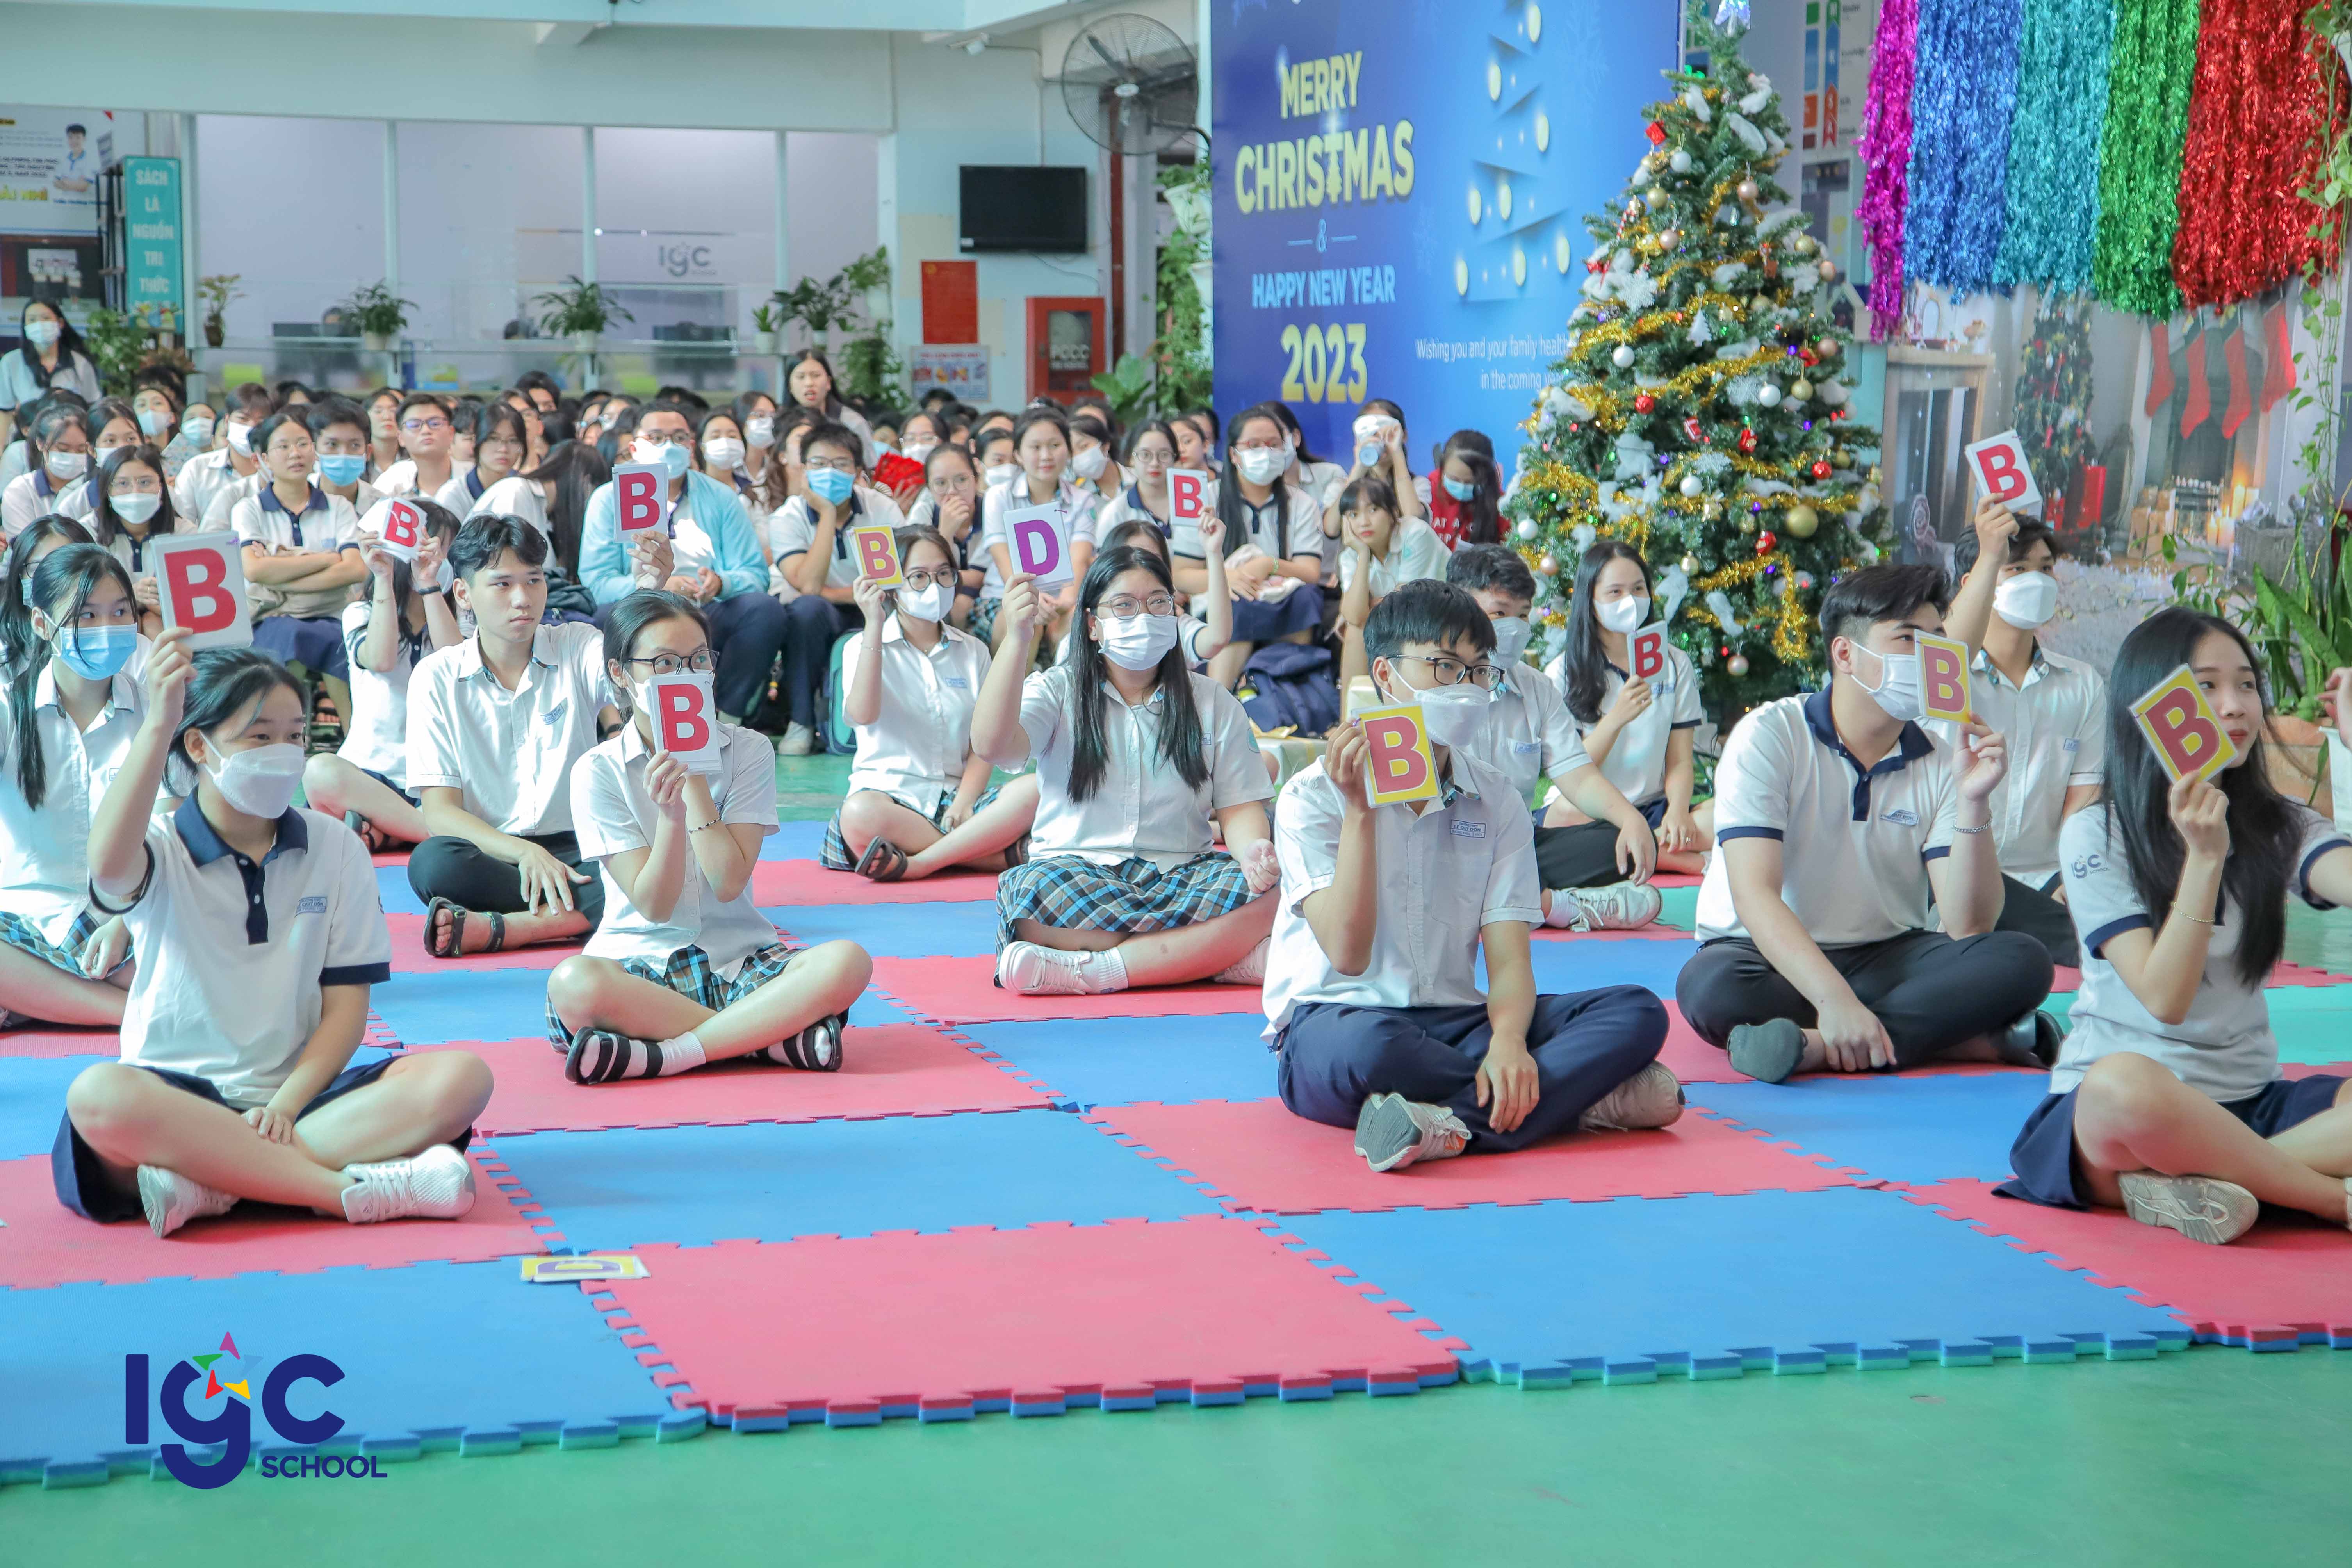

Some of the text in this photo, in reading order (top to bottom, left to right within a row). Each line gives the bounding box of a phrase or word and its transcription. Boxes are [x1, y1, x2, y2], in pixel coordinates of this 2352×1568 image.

[1280, 50, 1363, 119] MERRY
[135, 167, 168, 185] SÁCH
[1235, 119, 1415, 215] CHRISTMAS
[144, 251, 164, 266] TRI
[1316, 218, 1327, 253] &
[1252, 264, 1397, 309] HAPPY NEW YEAR
[1280, 323, 1367, 404] 2023
[1415, 337, 1450, 363] Wishing
[1451, 342, 1468, 362] you
[1469, 335, 1485, 358] and
[1487, 340, 1507, 362] your
[1509, 334, 1538, 360] family
[1481, 369, 1489, 390] in
[1491, 368, 1506, 388] the
[1508, 368, 1542, 391] coming
[620, 473, 659, 529] B
[1174, 475, 1204, 518] B
[1976, 444, 2026, 502] B
[385, 502, 419, 547] B
[1014, 520, 1058, 576] D
[859, 532, 896, 579] B
[165, 548, 236, 633] B
[1635, 633, 1663, 678] B
[1924, 647, 1965, 712] B
[659, 684, 709, 752] B
[2145, 688, 2220, 775] B
[1365, 716, 1428, 794] B
